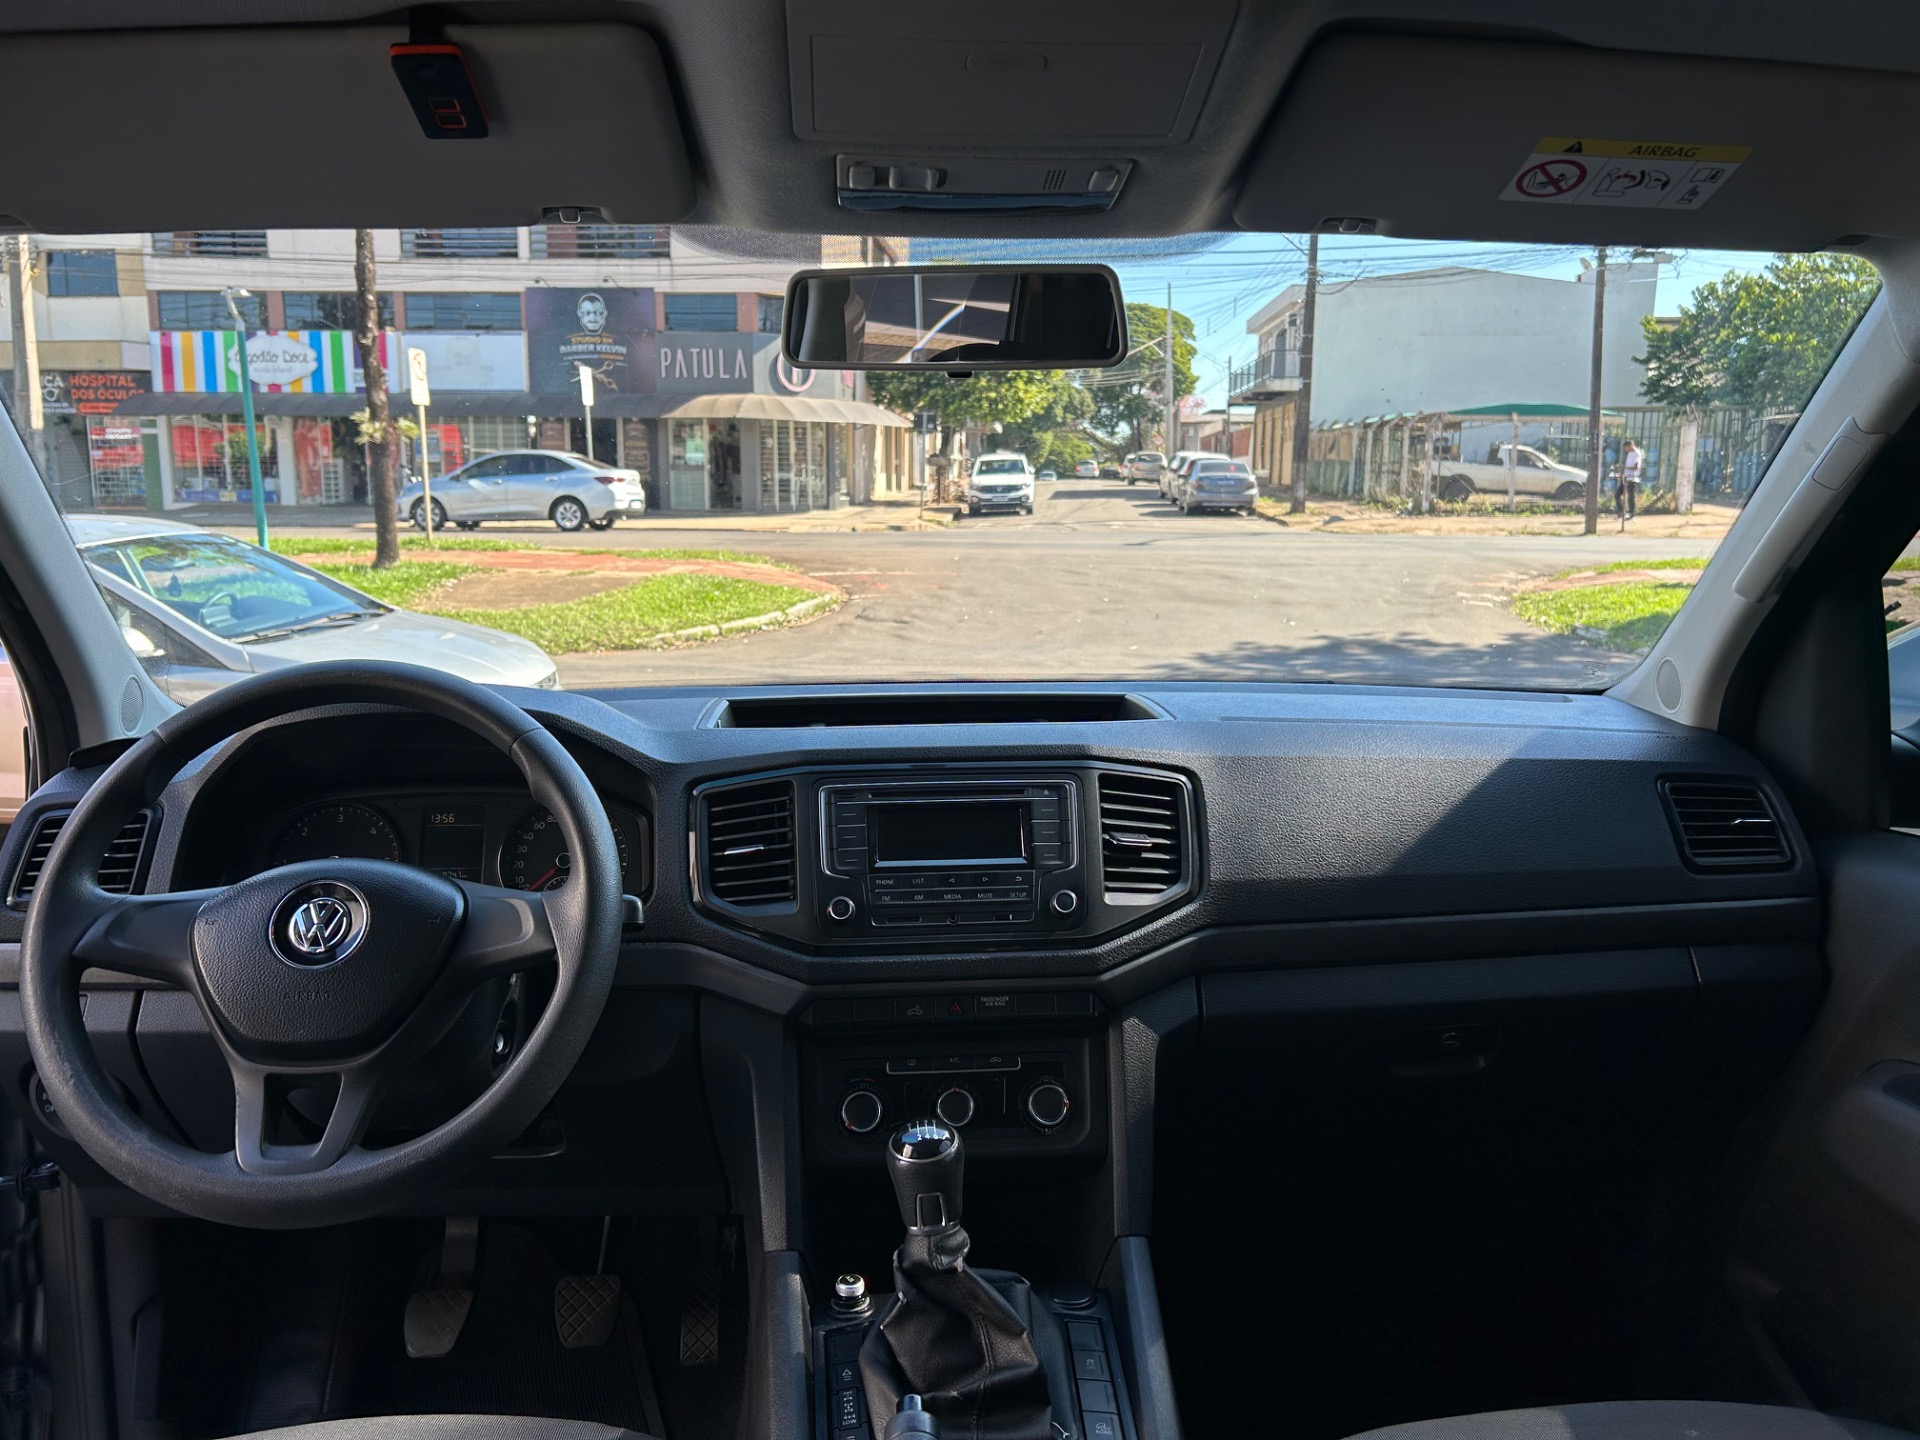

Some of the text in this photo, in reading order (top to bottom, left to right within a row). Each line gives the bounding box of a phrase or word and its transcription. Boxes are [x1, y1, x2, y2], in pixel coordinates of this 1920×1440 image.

[1628, 145, 1700, 158] AIRBAG
[559, 344, 627, 355] BARBER KELVIN
[283, 350, 309, 363] Doce
[660, 348, 748, 379] PATULA
[40, 374, 64, 388] ICA
[69, 374, 136, 388] HOSPITAL
[71, 388, 95, 400] DOS
[337, 814, 344, 823] 3
[431, 813, 455, 823] 13:56
[301, 828, 308, 836] 2
[370, 827, 376, 835] 4
[522, 832, 534, 840] 40
[516, 845, 528, 853] 30
[513, 861, 524, 869] 20
[515, 875, 525, 884] 10
[917, 1133, 923, 1141] 2
[933, 1132, 938, 1140] 6
